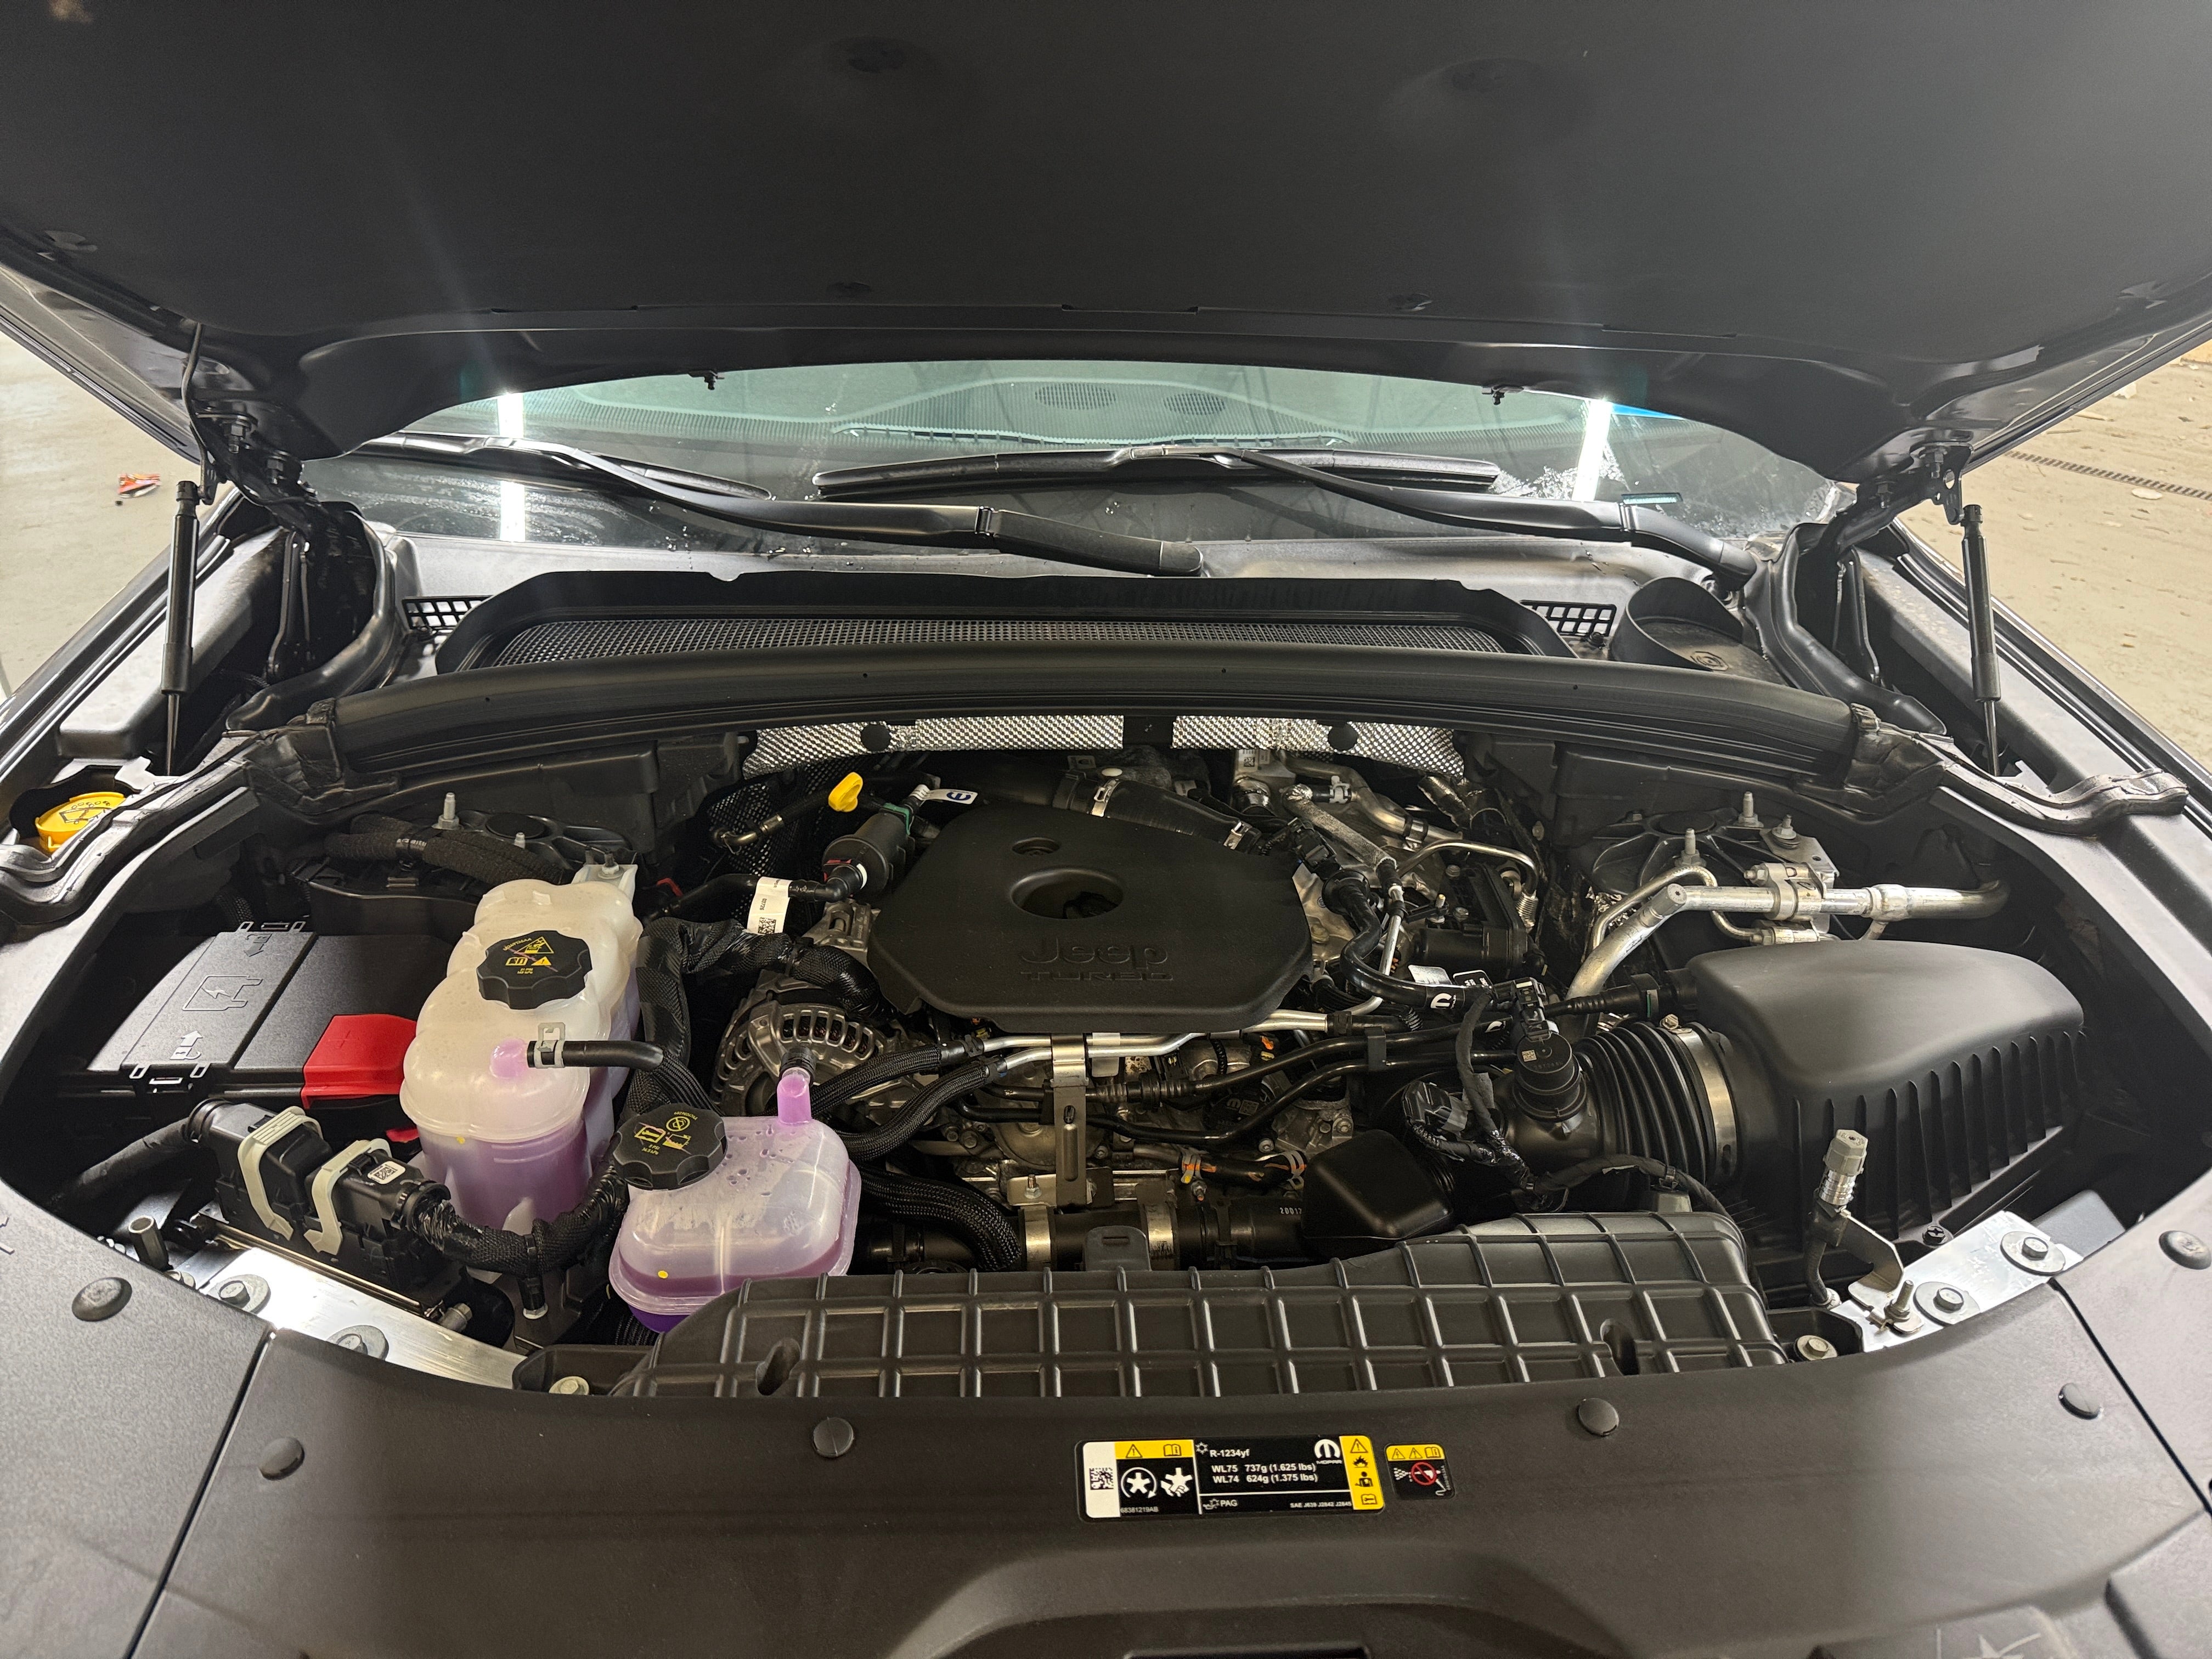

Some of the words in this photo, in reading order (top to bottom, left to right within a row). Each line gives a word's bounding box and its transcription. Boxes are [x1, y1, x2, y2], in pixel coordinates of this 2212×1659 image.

[1020, 937, 1169, 970] Jeep
[1210, 1448, 1250, 1458] R-1234yf
[1211, 1465, 1238, 1473] WL75
[1244, 1464, 1268, 1474] 737g
[1269, 1463, 1297, 1473] (1.625
[1299, 1463, 1316, 1472] lbs)
[1212, 1475, 1240, 1483] WL74
[1246, 1475, 1269, 1484] 624g
[1271, 1474, 1299, 1483] (1.375
[1300, 1473, 1318, 1482] lbs)
